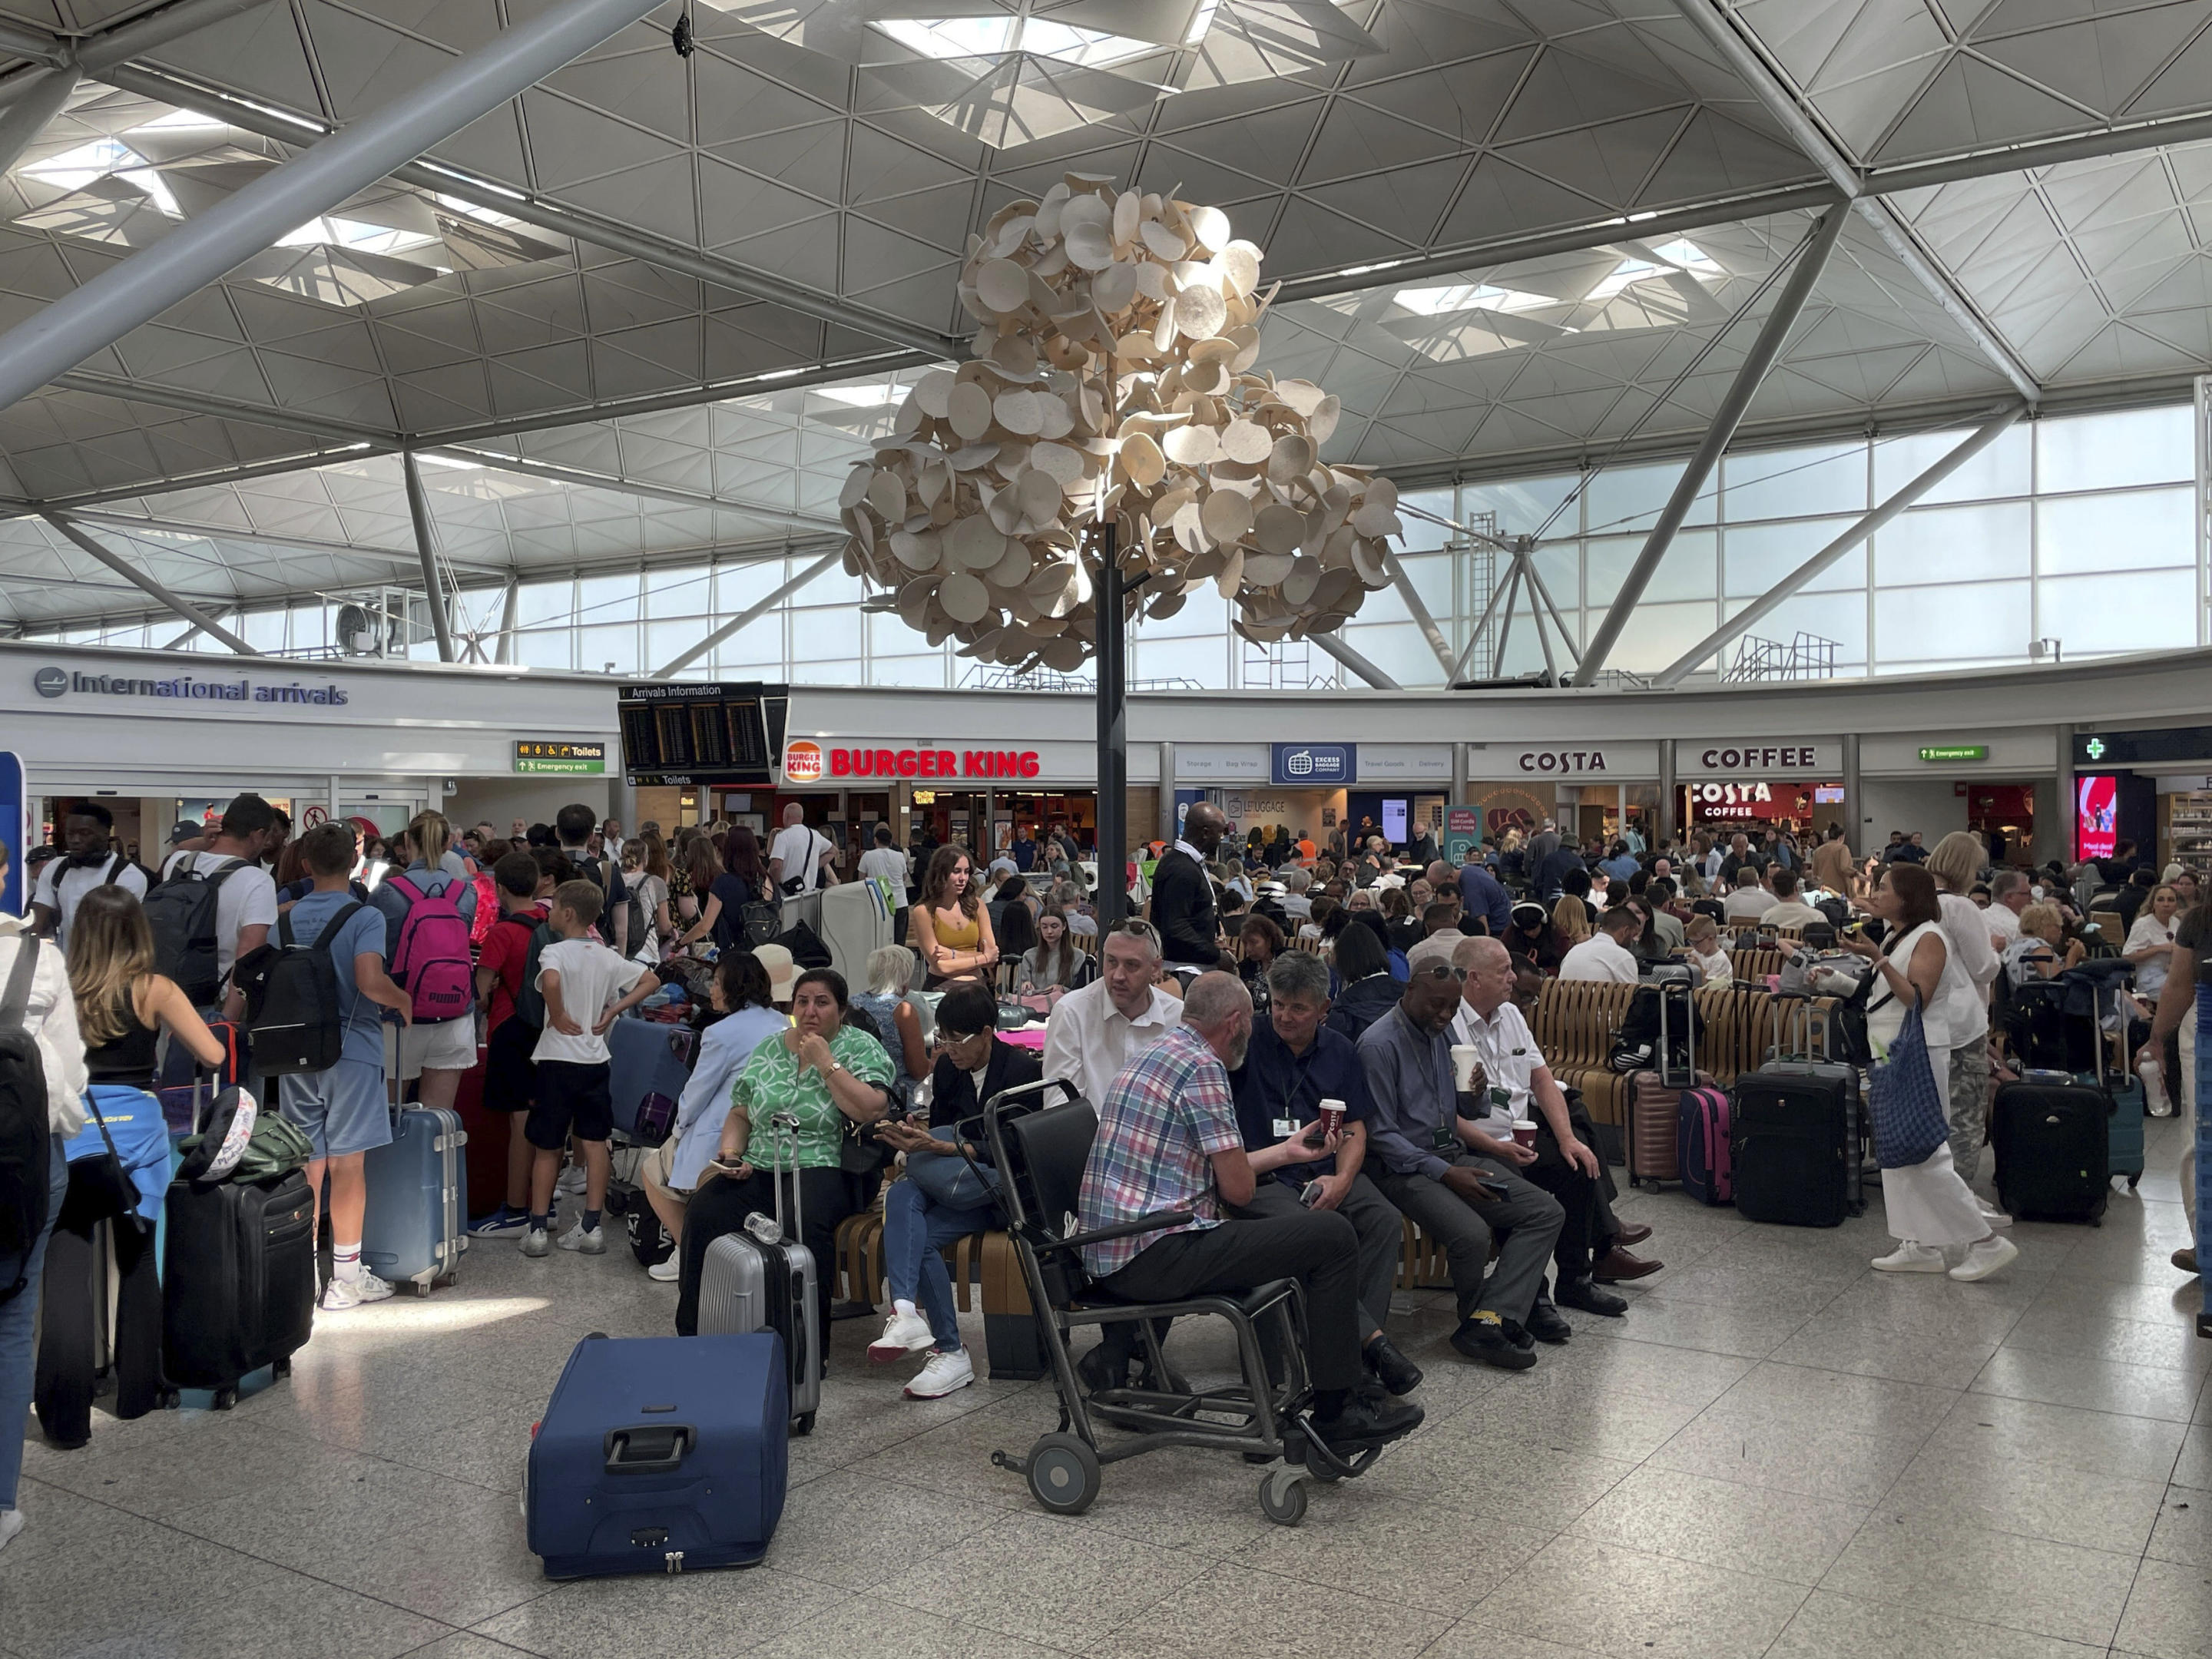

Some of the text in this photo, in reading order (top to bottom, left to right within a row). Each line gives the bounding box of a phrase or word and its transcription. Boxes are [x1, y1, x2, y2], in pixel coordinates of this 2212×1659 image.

[74, 671, 349, 705] International arrivals
[632, 685, 721, 698] Arrivals Information
[571, 747, 601, 757] Toilets
[1701, 747, 1816, 769] COFFEE
[537, 763, 574, 771] Emergency
[787, 761, 821, 772] KING
[830, 748, 1040, 779] BURGER KING
[1518, 752, 1607, 773] COSTA
[661, 775, 691, 784] Toilets
[1684, 782, 1772, 805] COSTA
[1704, 807, 1753, 816] COFFEE
[429, 992, 461, 1004] PUMA
[1329, 1110, 1338, 1131] COSTA
